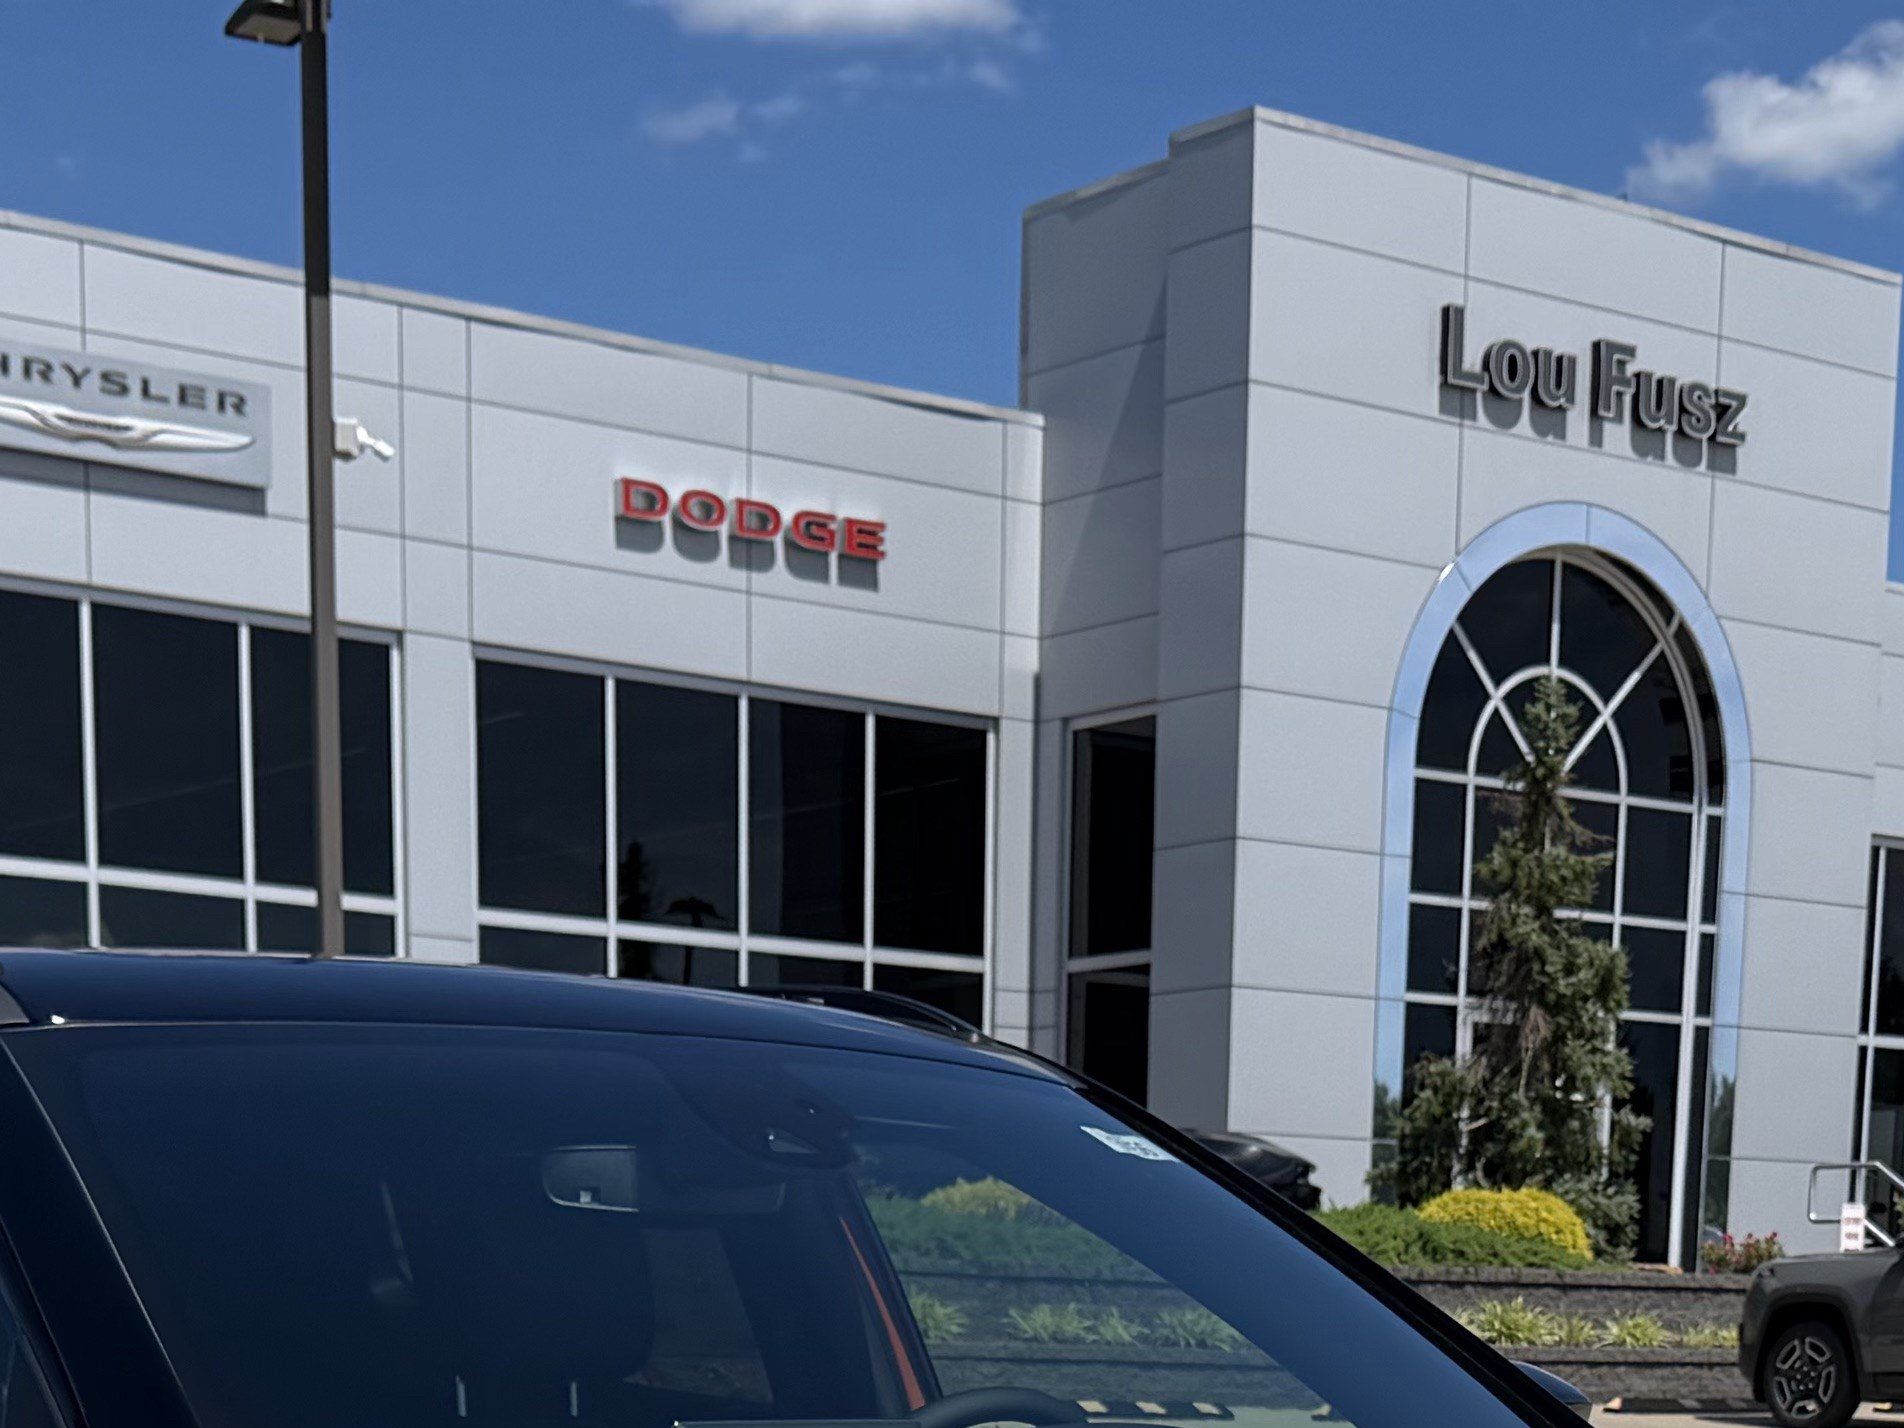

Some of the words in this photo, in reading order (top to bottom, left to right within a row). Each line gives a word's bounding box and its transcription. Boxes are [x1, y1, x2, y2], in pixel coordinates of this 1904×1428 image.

[1440, 303, 1577, 410] Lou
[1590, 338, 1749, 446] Fusz
[614, 475, 887, 561] DODGE
